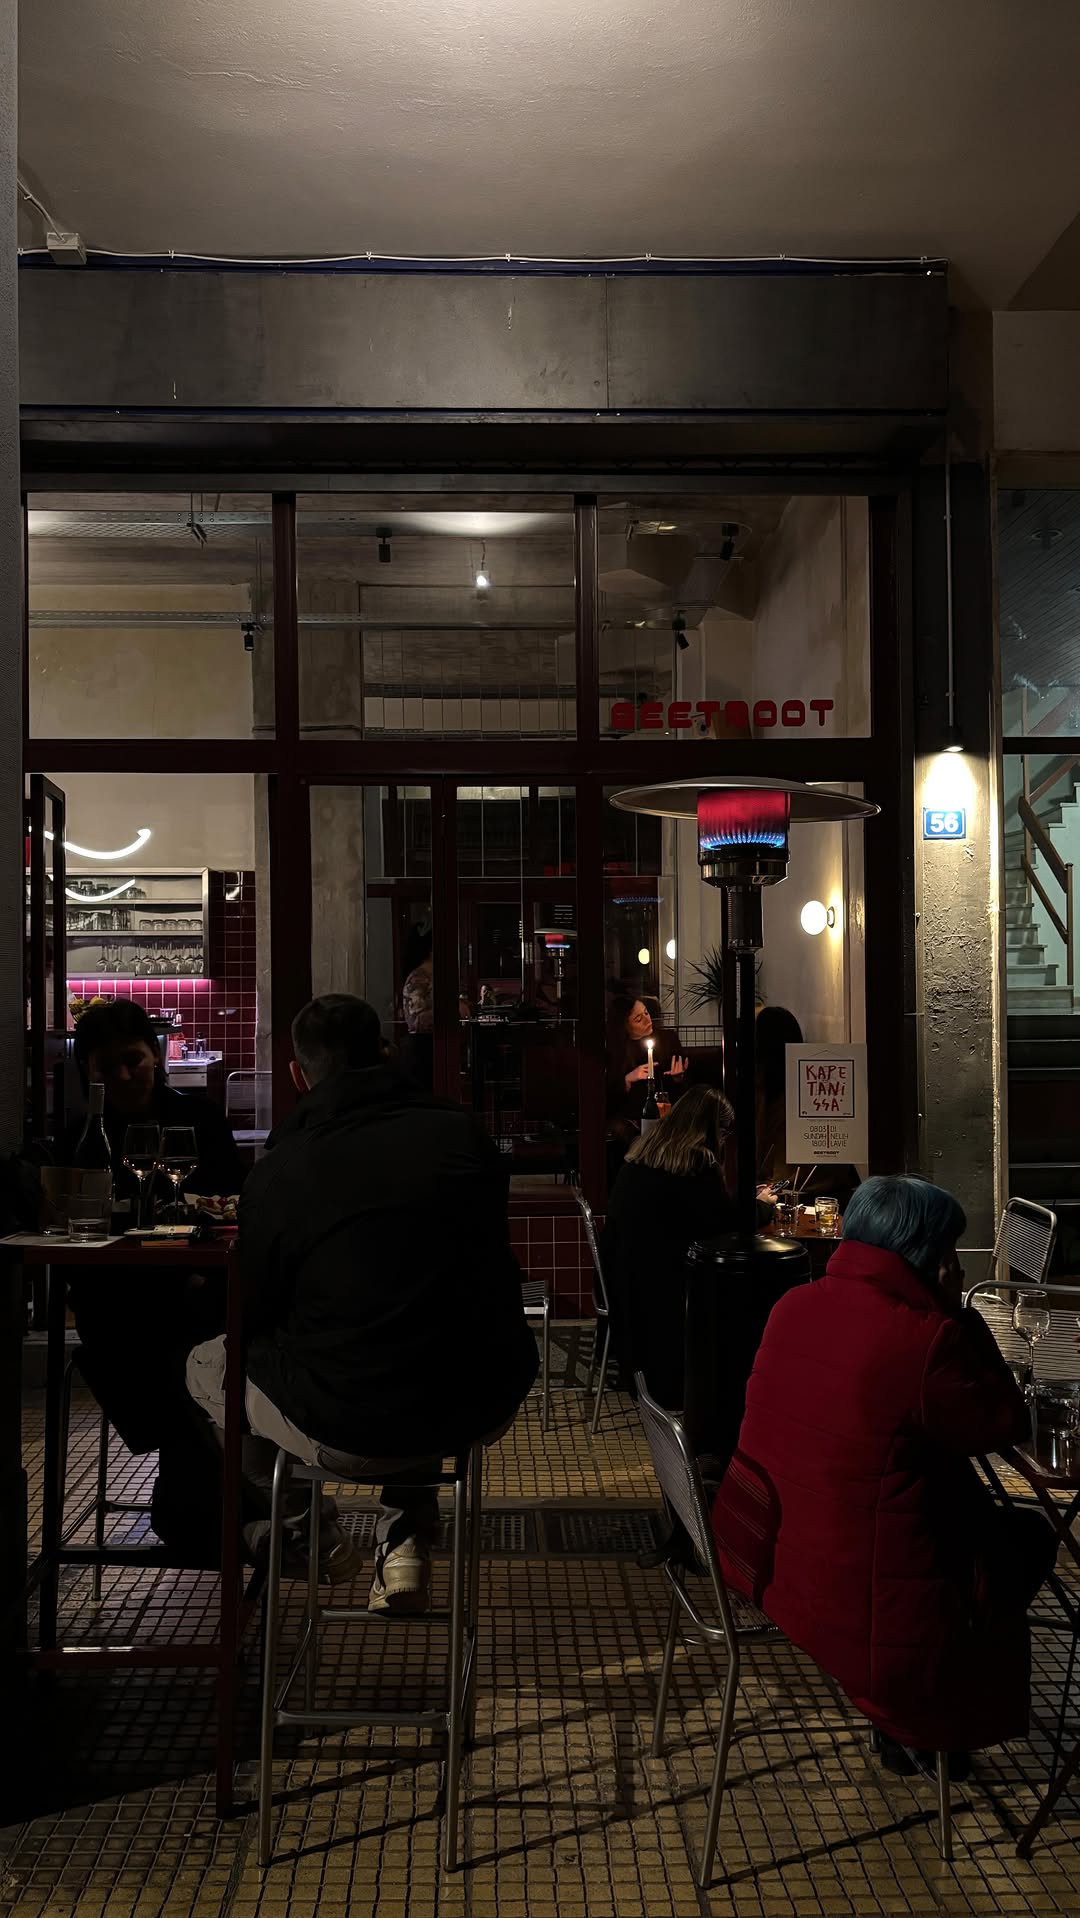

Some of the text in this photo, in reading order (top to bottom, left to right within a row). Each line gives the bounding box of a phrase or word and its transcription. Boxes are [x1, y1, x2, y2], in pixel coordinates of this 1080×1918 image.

[611, 699, 834, 729] BEETROOT
[930, 812, 959, 833] 56
[806, 1065, 847, 1080] KAPE
